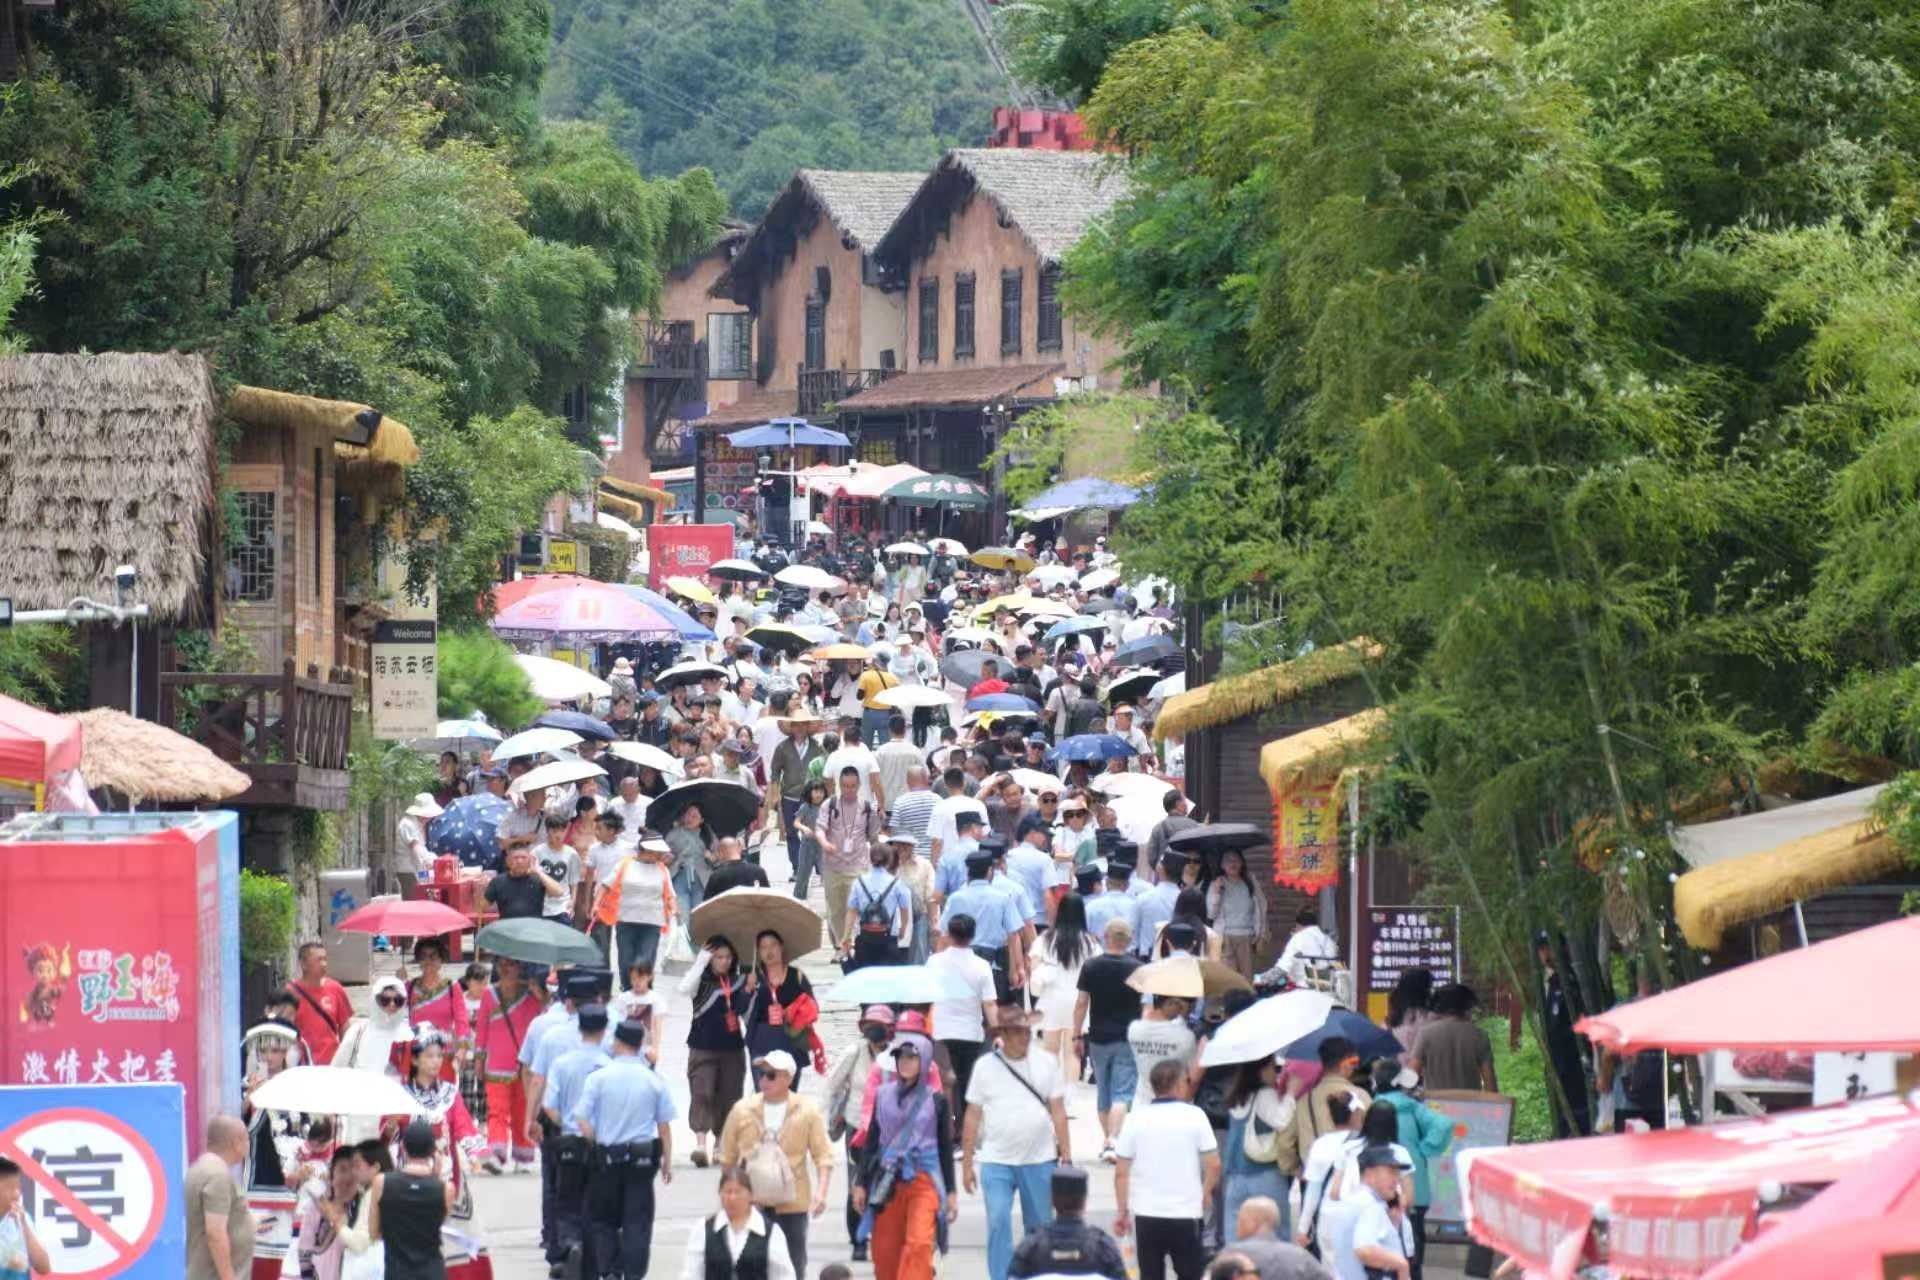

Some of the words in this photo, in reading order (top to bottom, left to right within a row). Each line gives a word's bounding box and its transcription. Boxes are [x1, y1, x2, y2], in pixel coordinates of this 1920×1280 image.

[393, 629, 433, 639] Welcome
[1298, 808, 1322, 869] 土豆饼
[22, 1048, 177, 1085] 激情火把季
[21, 1145, 125, 1248] 停
